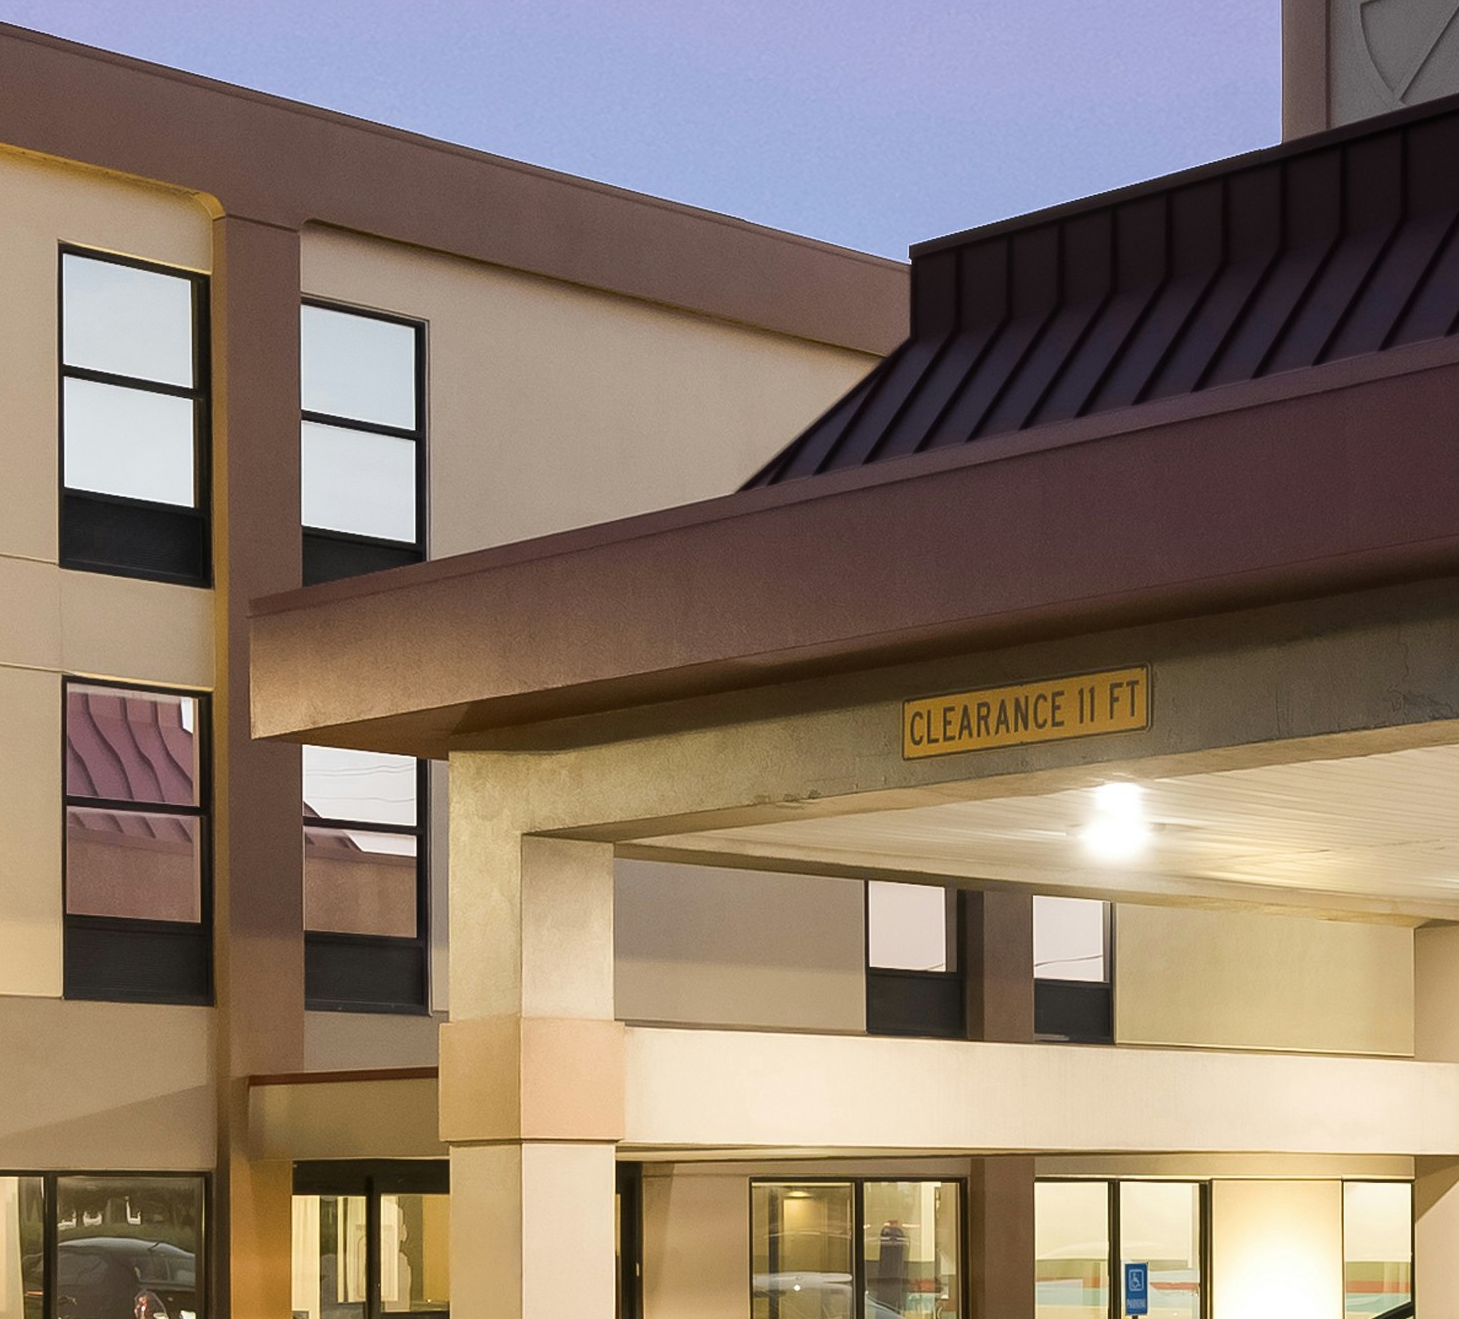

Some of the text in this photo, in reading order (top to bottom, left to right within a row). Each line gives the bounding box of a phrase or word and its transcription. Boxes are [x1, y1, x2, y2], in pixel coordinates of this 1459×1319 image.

[909, 680, 1140, 747] CLEARANCE 11 FT
